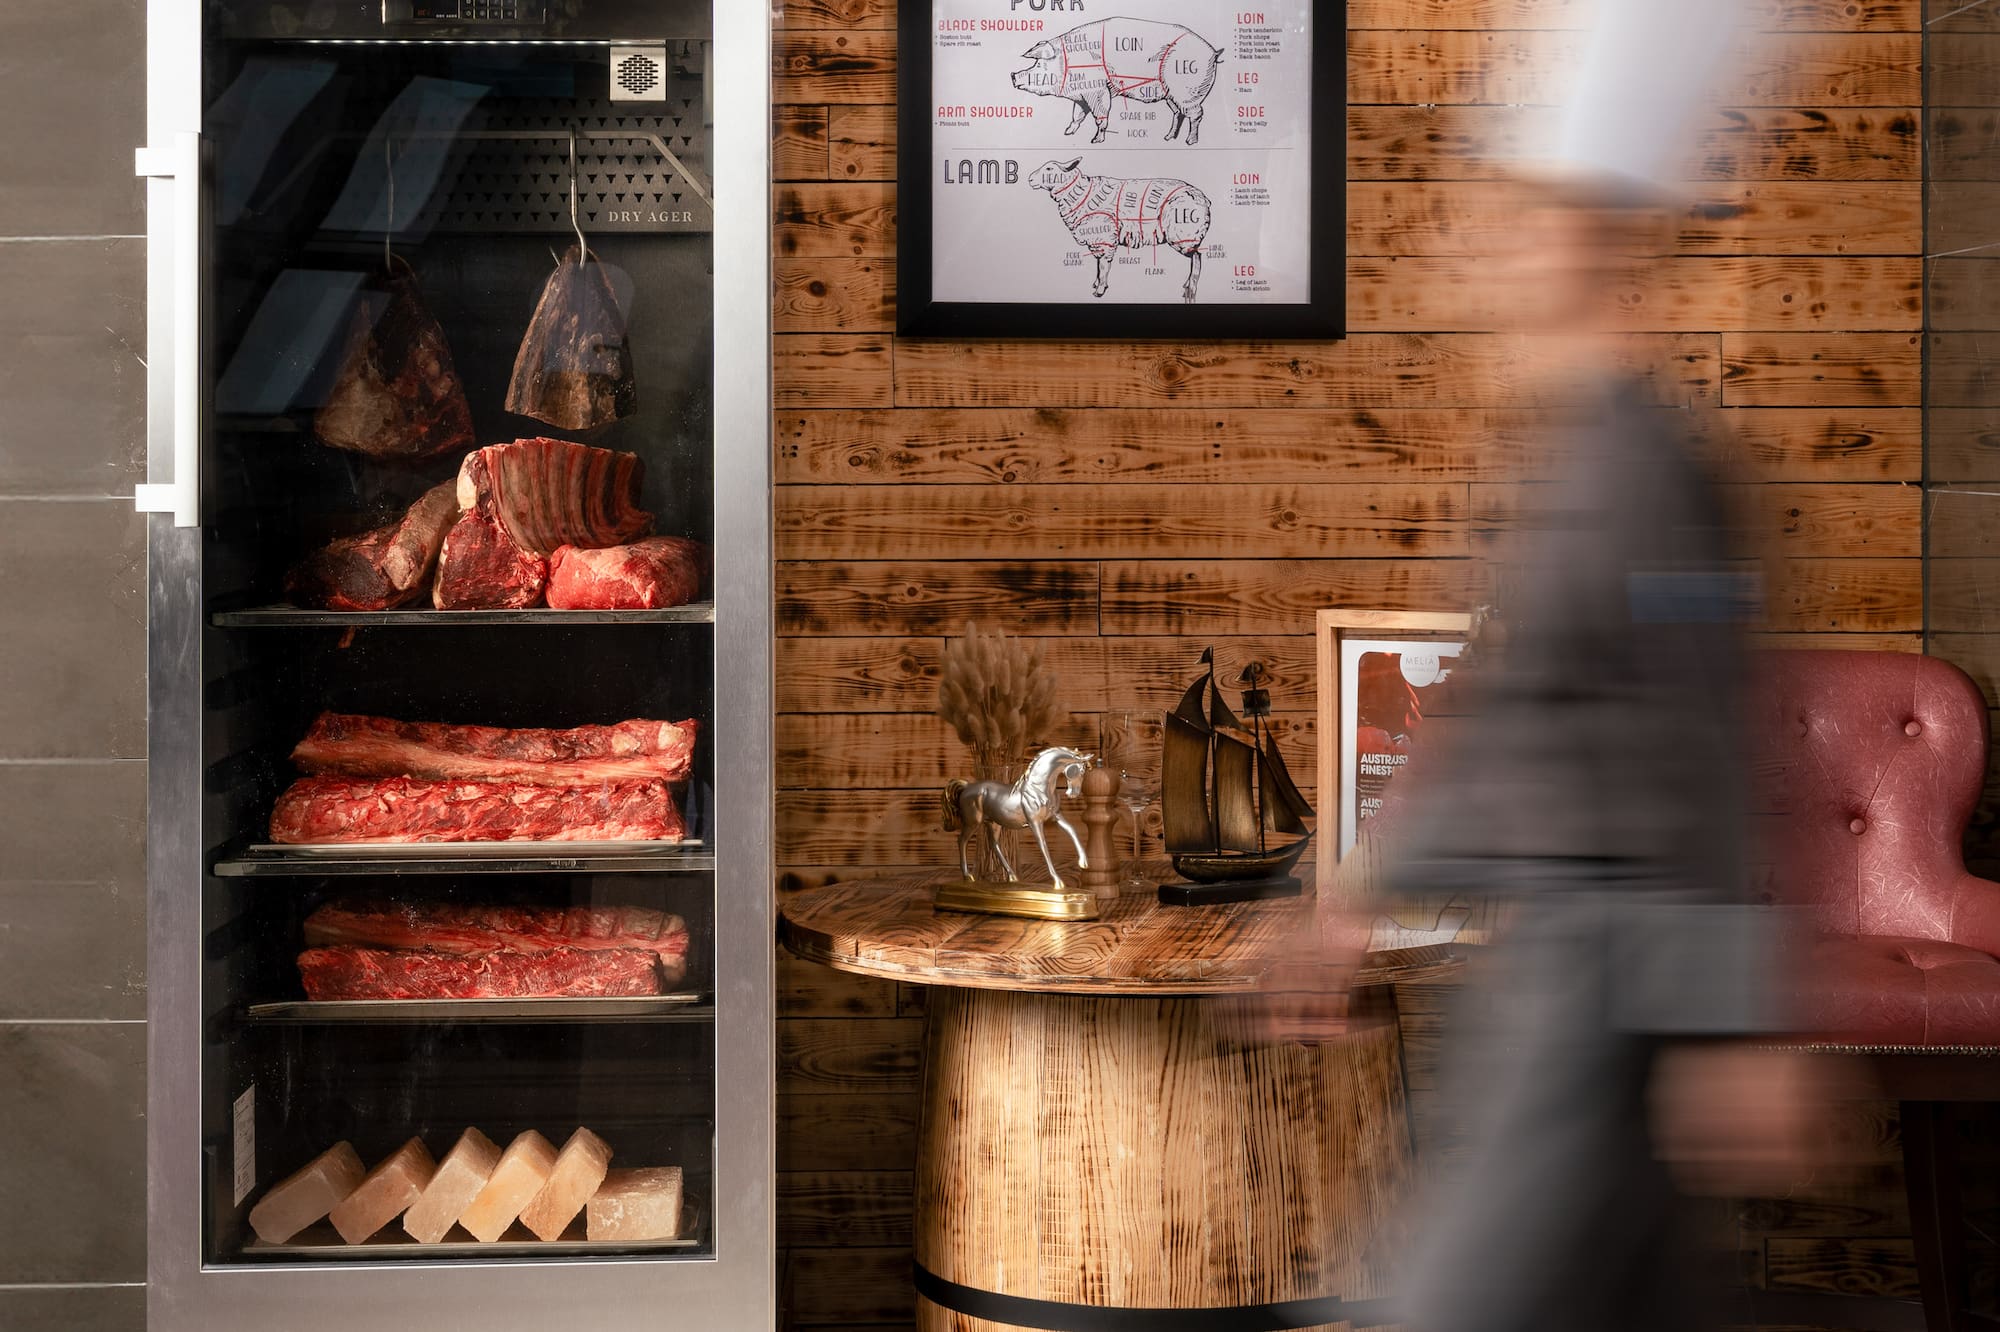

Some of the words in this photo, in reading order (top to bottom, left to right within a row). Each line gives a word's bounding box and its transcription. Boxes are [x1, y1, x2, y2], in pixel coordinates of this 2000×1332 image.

[1238, 13, 1264, 24] LOIN
[939, 20, 975, 31] BLADE
[980, 20, 1044, 31] SHOULDER
[1116, 37, 1144, 51] LOIN
[1175, 60, 1198, 74] LEG
[1028, 73, 1058, 86] HEAD
[1238, 73, 1258, 84] LEG
[1140, 86, 1159, 98] SIDE
[938, 106, 965, 117] ARM
[970, 106, 1033, 117] SHOULDER
[1238, 106, 1264, 117] SIDE
[944, 160, 1018, 184] LAMB
[1234, 174, 1259, 184] LOIN
[1088, 182, 1116, 210] CHUCK
[1124, 192, 1138, 208] RIB
[1146, 185, 1164, 210] LOIN
[608, 211, 641, 222] DRY
[648, 211, 692, 222] AGER
[1175, 208, 1199, 224] LEG
[1234, 265, 1255, 276] LEG
